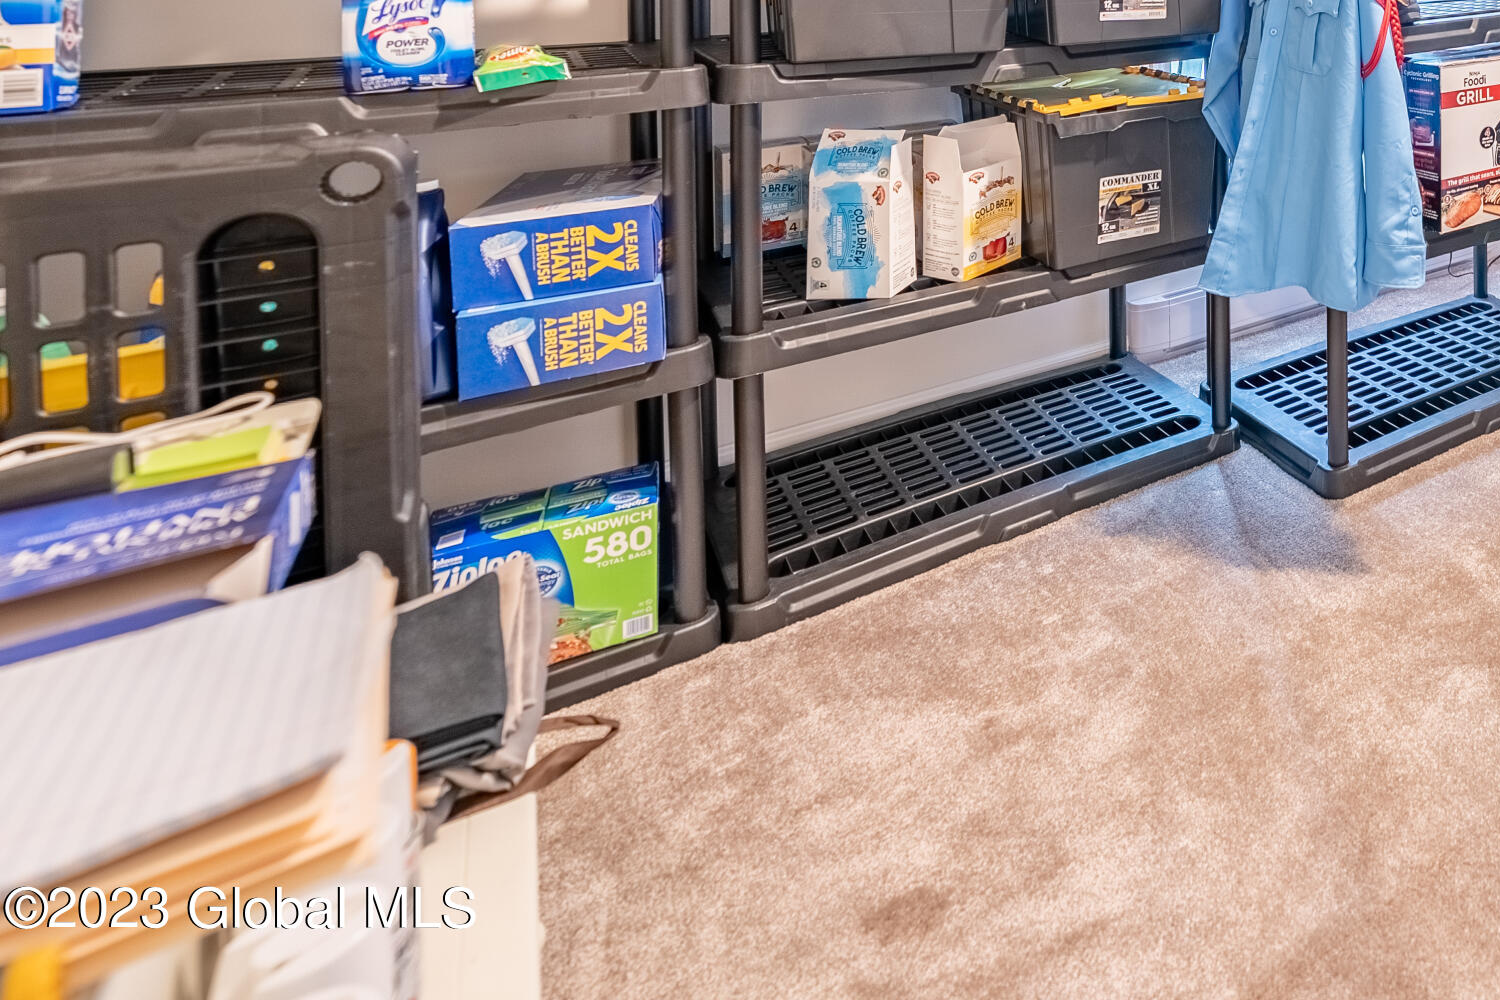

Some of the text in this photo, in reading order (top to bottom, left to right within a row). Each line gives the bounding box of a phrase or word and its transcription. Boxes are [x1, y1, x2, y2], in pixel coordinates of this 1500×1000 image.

[386, 38, 429, 48] POWER
[1463, 75, 1487, 88] Foodi
[1456, 88, 1494, 105] GRILL
[836, 145, 880, 156] COLD BREW
[769, 183, 797, 193] BREW
[1102, 172, 1160, 187] COMMANDER
[1147, 182, 1160, 191] XL
[1448, 179, 1458, 187] The
[1458, 177, 1469, 185] grill
[974, 198, 1014, 220] COLD BREW
[789, 222, 798, 231] 4
[854, 208, 866, 266] COLD BREW
[586, 222, 625, 277] 2X
[624, 220, 640, 272] CLEANS
[1008, 237, 1015, 246] 4
[535, 232, 551, 285] A BRUSH
[550, 228, 570, 284] THAN
[595, 303, 633, 361] 2X
[633, 301, 648, 353] CLEANS
[544, 318, 559, 371] A BRUSH
[558, 312, 578, 368] THAN
[562, 509, 653, 540] SANDWICH
[583, 525, 653, 565] 580
[597, 549, 653, 568] TOTAL BAGS
